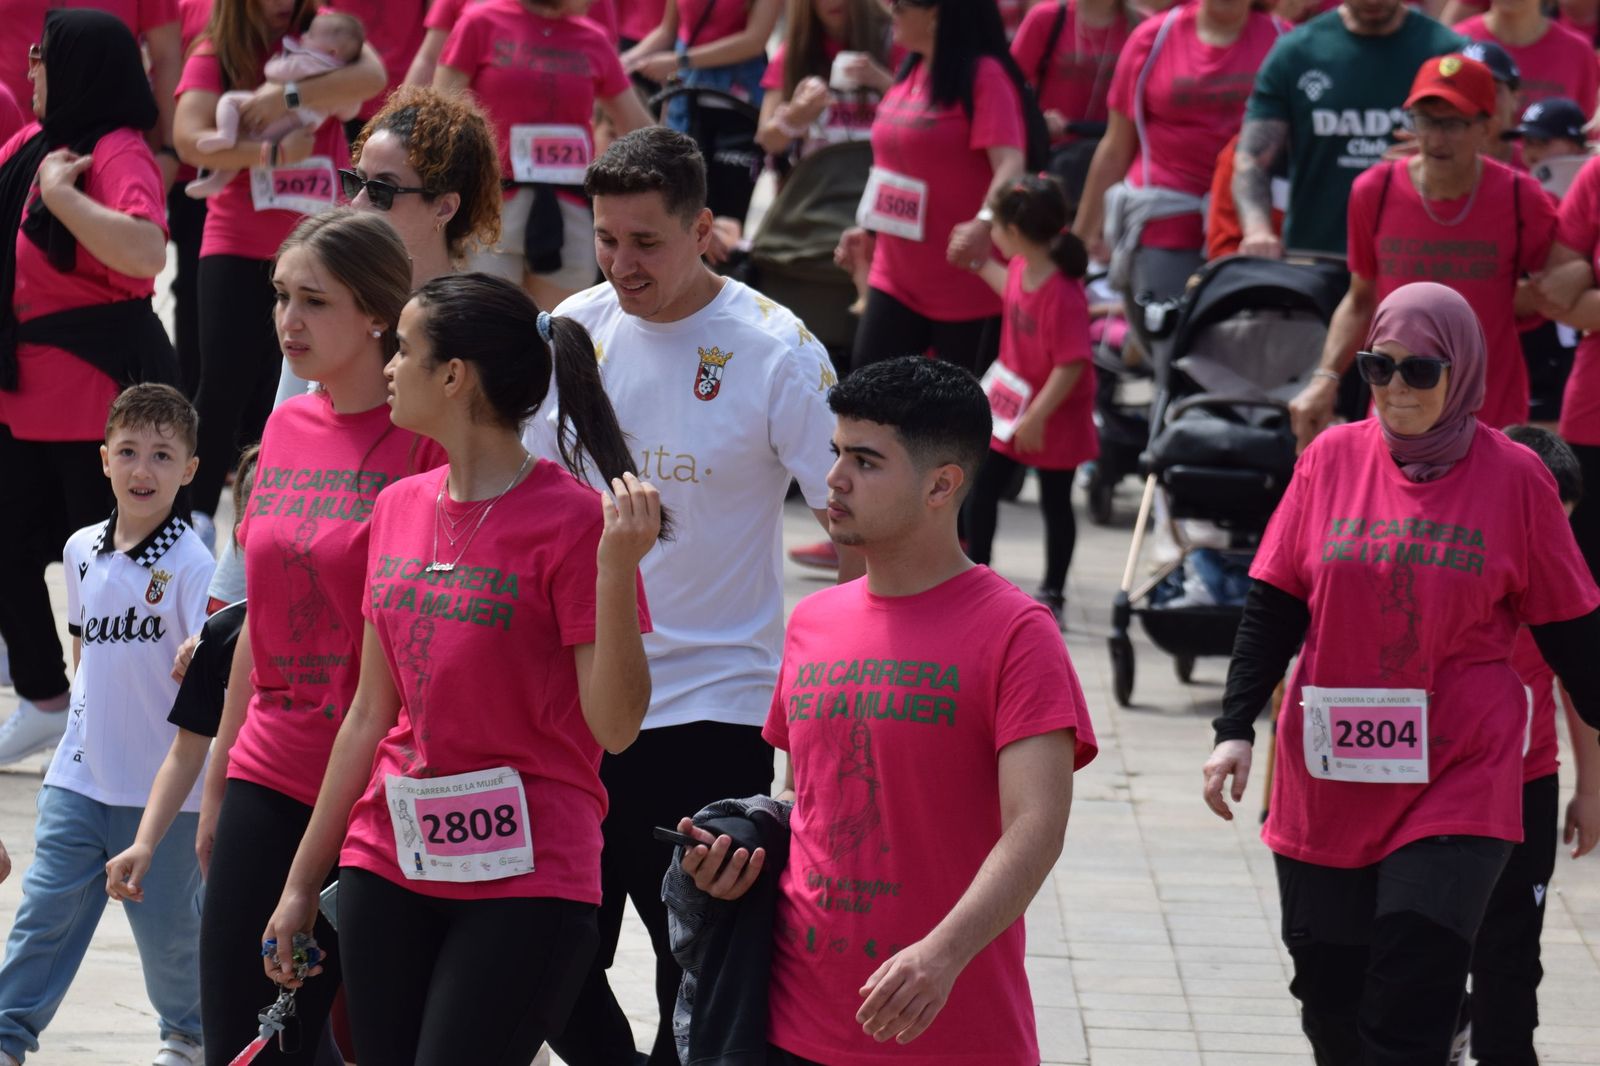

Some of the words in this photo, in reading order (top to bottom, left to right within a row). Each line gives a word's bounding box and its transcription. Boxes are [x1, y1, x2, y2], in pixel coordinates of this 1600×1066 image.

[534, 145, 586, 164] 1521
[275, 175, 331, 197] 2072
[258, 467, 293, 490] XXI
[292, 468, 400, 494] CARRER
[306, 495, 376, 523] MUJE
[1328, 517, 1367, 537] XXI
[1369, 517, 1485, 549] CARRERA
[1322, 540, 1355, 562] DE
[1395, 542, 1485, 577] MUJER
[400, 558, 519, 600] CARRERA
[371, 583, 385, 609] E
[420, 590, 514, 632] MUJER
[82, 606, 166, 644] euta
[793, 661, 827, 689] XXI
[827, 659, 960, 692] CARRERA
[788, 692, 813, 722] DE
[854, 692, 958, 726] MUJER
[1333, 696, 1366, 704] CARRERA
[1335, 719, 1417, 748] 2804
[416, 785, 450, 796] CARRERA
[452, 784, 463, 793] DE
[464, 782, 476, 791] LA
[476, 777, 504, 789] MUJER
[422, 803, 518, 844] 2808
